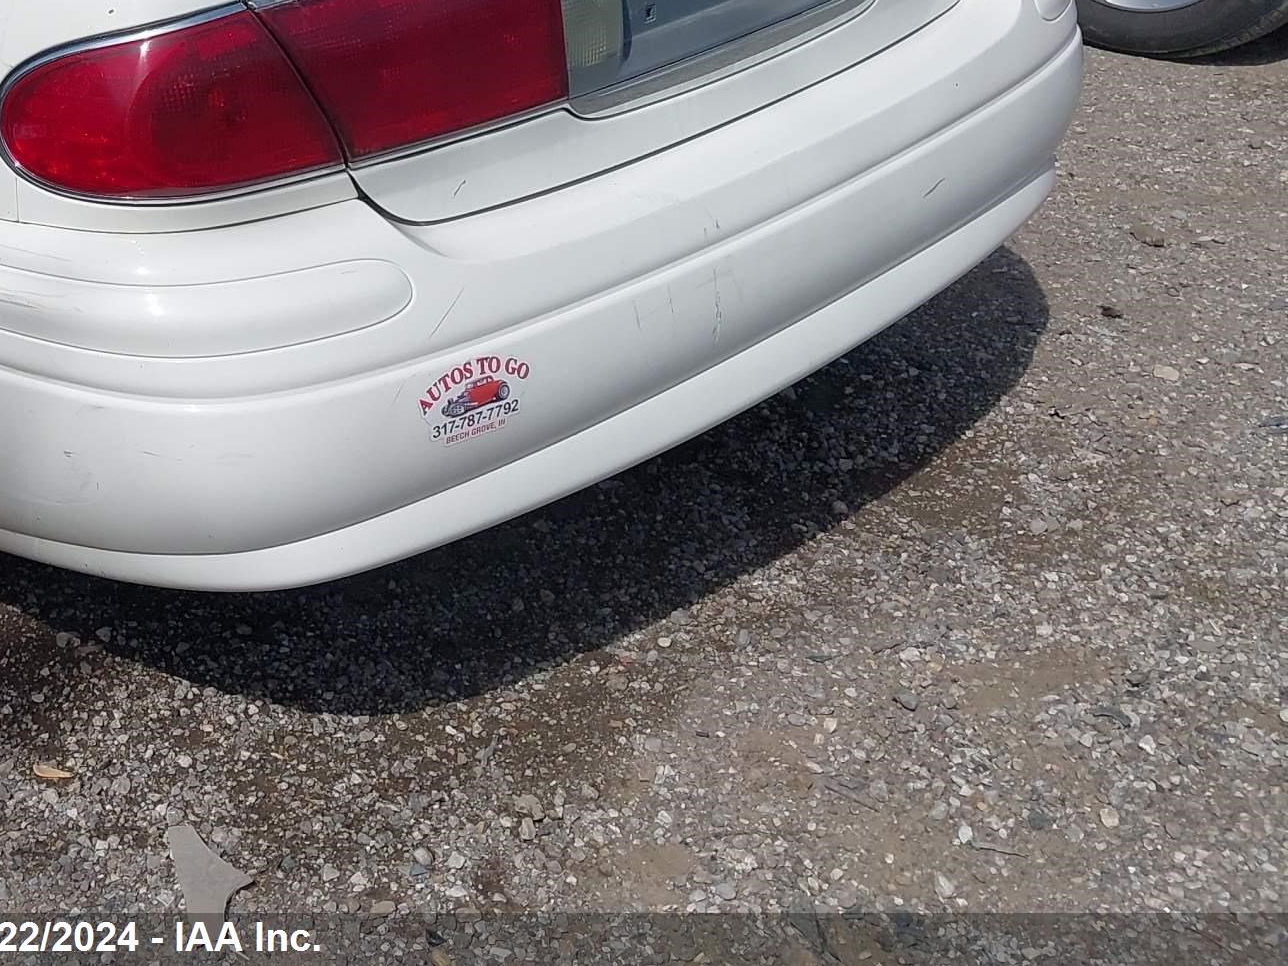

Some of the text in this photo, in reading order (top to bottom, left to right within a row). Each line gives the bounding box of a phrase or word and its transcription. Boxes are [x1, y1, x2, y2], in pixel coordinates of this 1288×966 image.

[419, 356, 530, 415] AUTOS TO GO
[432, 399, 519, 439] 317-787-7792
[446, 431, 470, 445] BEECH
